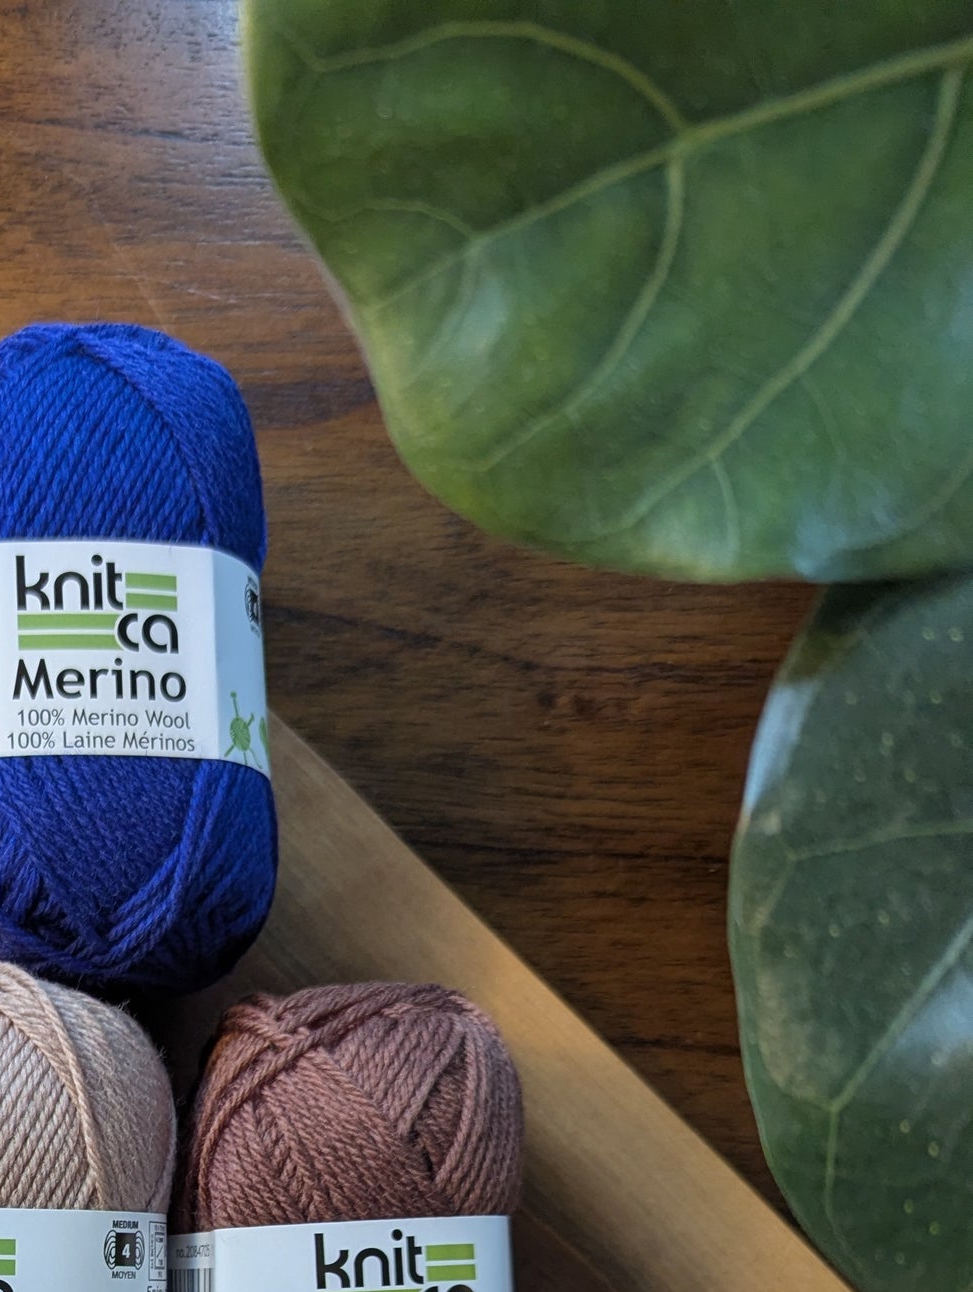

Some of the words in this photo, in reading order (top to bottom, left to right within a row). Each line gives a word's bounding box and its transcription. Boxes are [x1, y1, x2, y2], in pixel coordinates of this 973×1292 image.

[15, 554, 124, 611] knit
[117, 613, 179, 654] ca
[12, 657, 186, 702] Merino
[17, 709, 65, 726] 100%
[72, 709, 139, 726] Merino
[145, 710, 190, 730] Wool
[7, 732, 55, 750] 100%
[63, 732, 115, 749] Laine
[123, 731, 195, 751] Mérinos
[112, 1220, 139, 1229] MEDIUM
[122, 1243, 131, 1259] 4
[314, 1228, 425, 1289] knit
[111, 1271, 137, 1280] MOYEN
